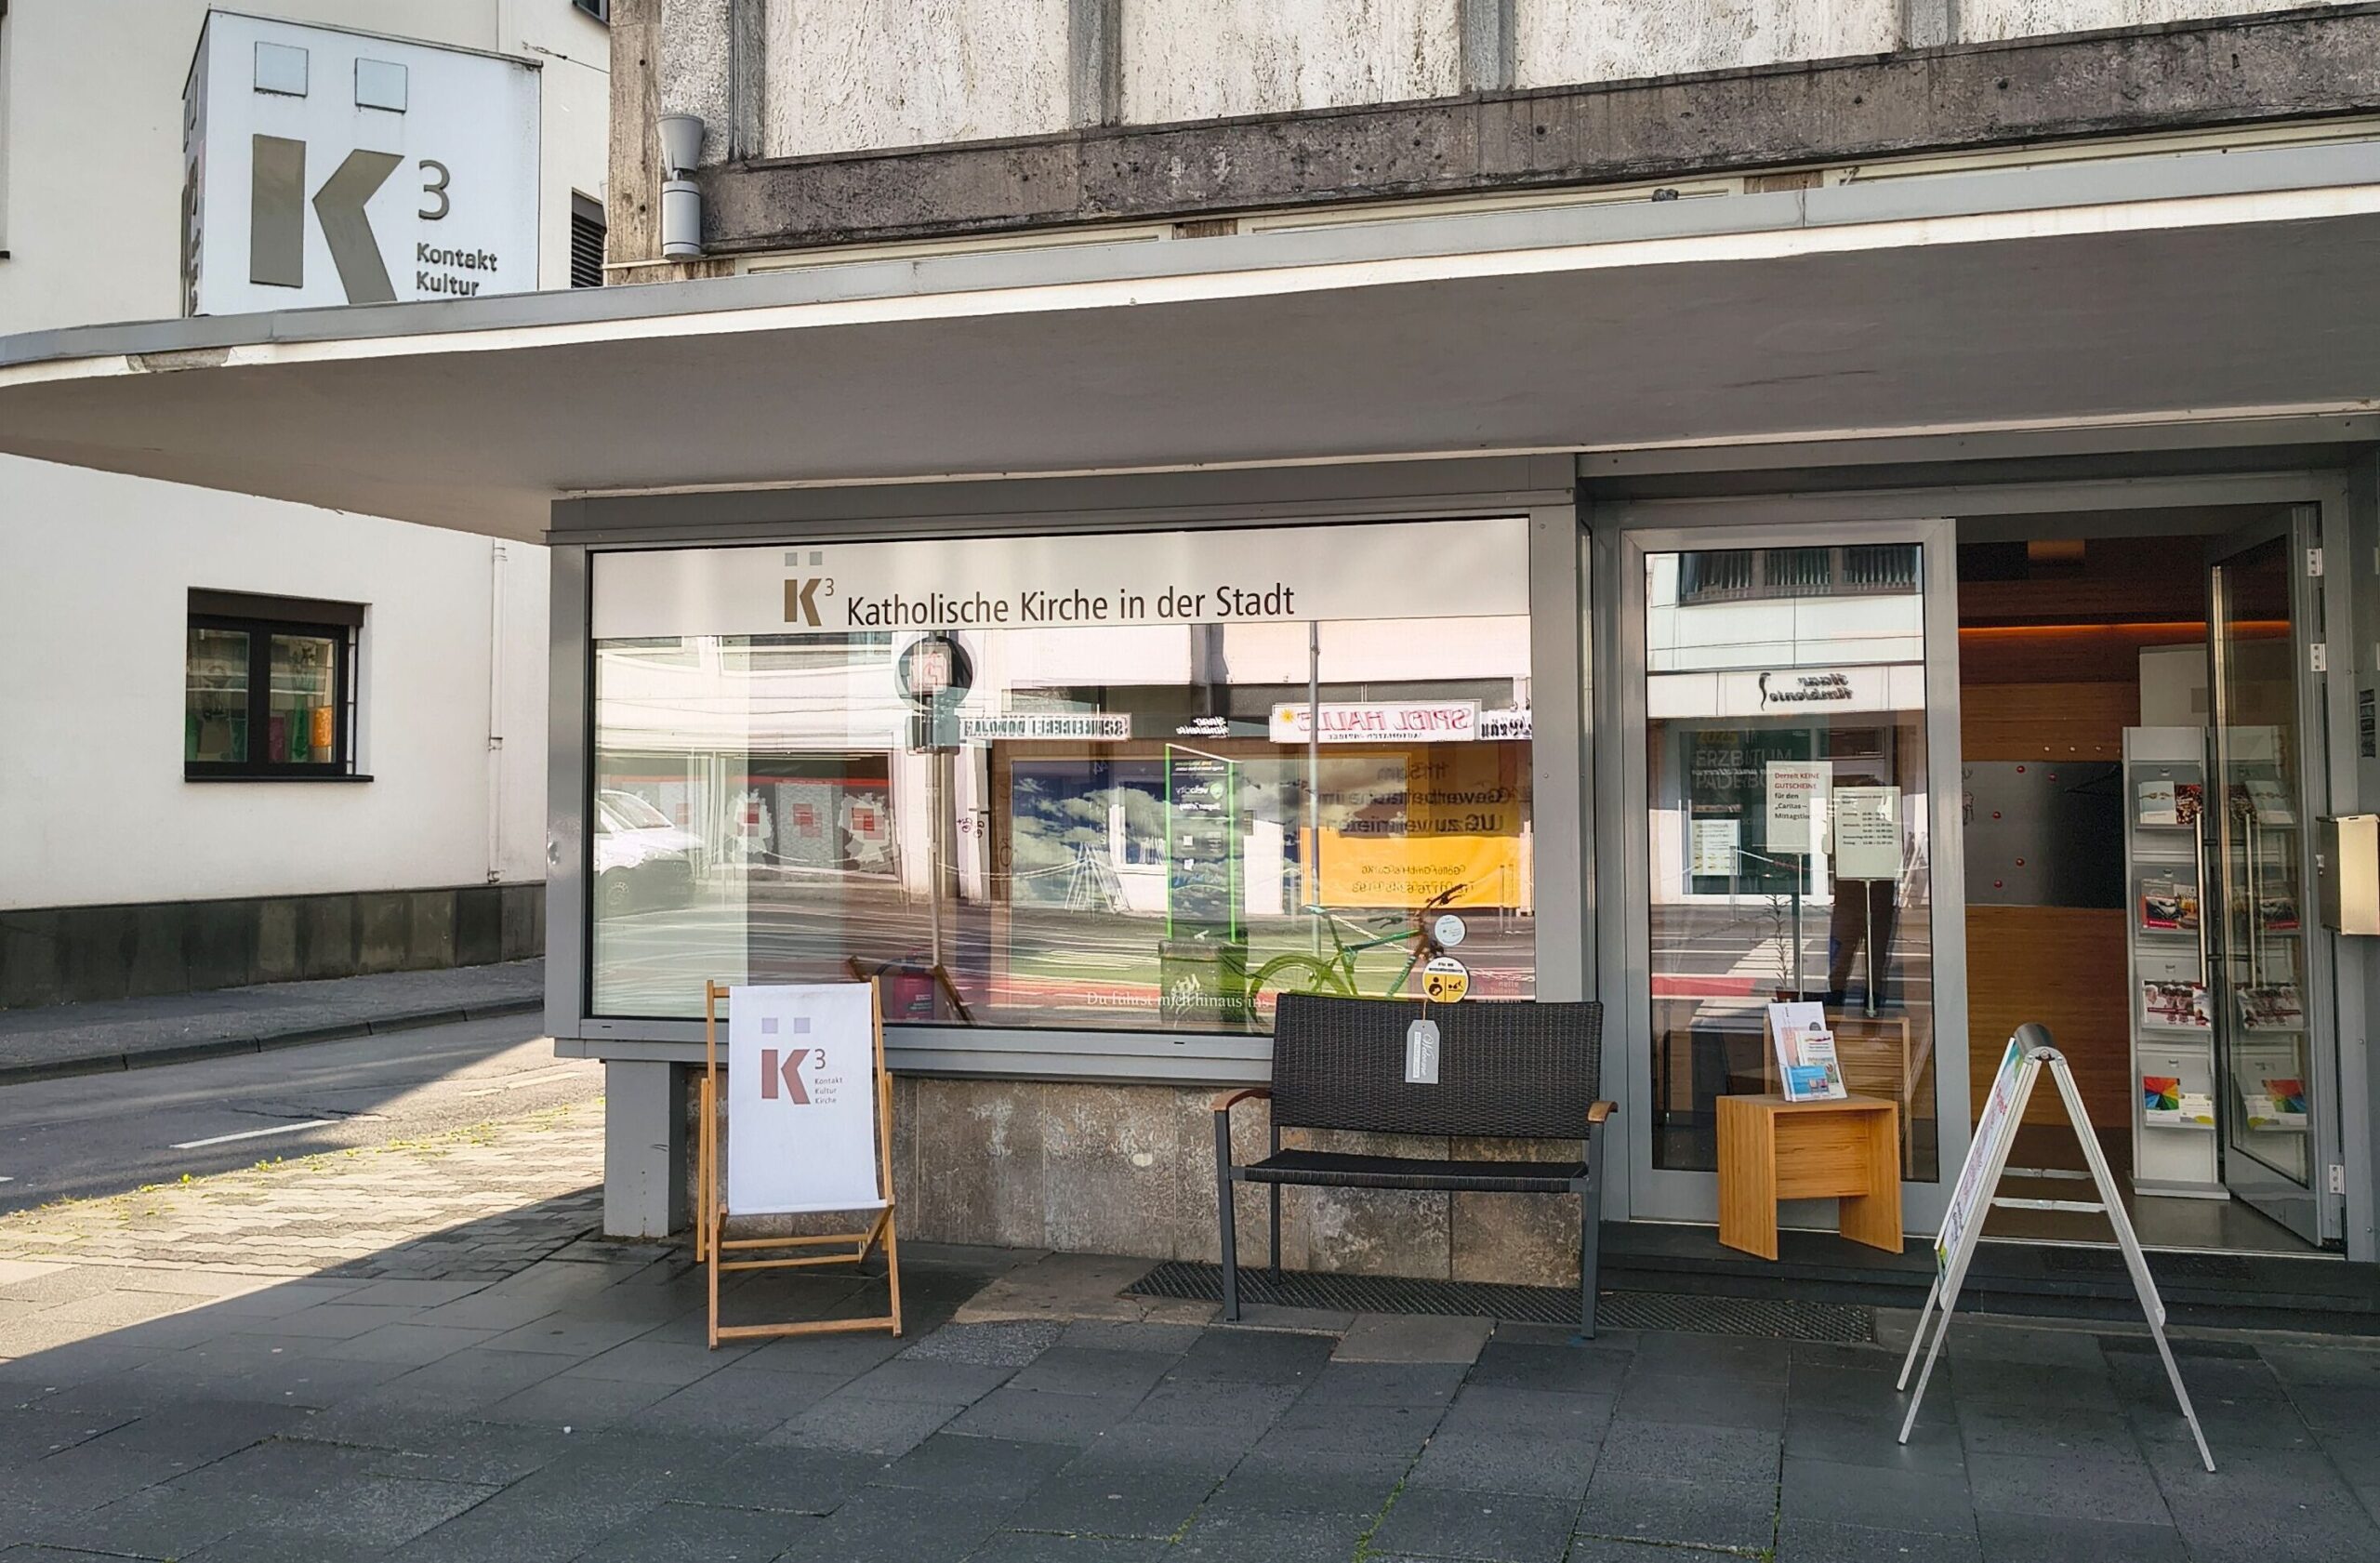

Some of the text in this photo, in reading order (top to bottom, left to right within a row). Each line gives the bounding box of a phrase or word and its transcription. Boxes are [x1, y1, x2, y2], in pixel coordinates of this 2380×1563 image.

[416, 242, 498, 272] Kontakt
[416, 270, 481, 296] Kultur
[847, 590, 1010, 627] Katholische
[1020, 589, 1109, 622] Kirche
[1119, 588, 1145, 619] in
[1156, 585, 1207, 618] der
[1215, 582, 1296, 616] Stadt
[1696, 774, 1767, 790] PADERBO
[1800, 772, 1819, 780] KEINE
[1086, 992, 1108, 1006] Du
[1112, 991, 1153, 1007] führst
[1157, 992, 1193, 1008] mich
[1196, 993, 1243, 1008] hinaus
[814, 1077, 843, 1085] Kontakt
[814, 1096, 837, 1105] Kirche
